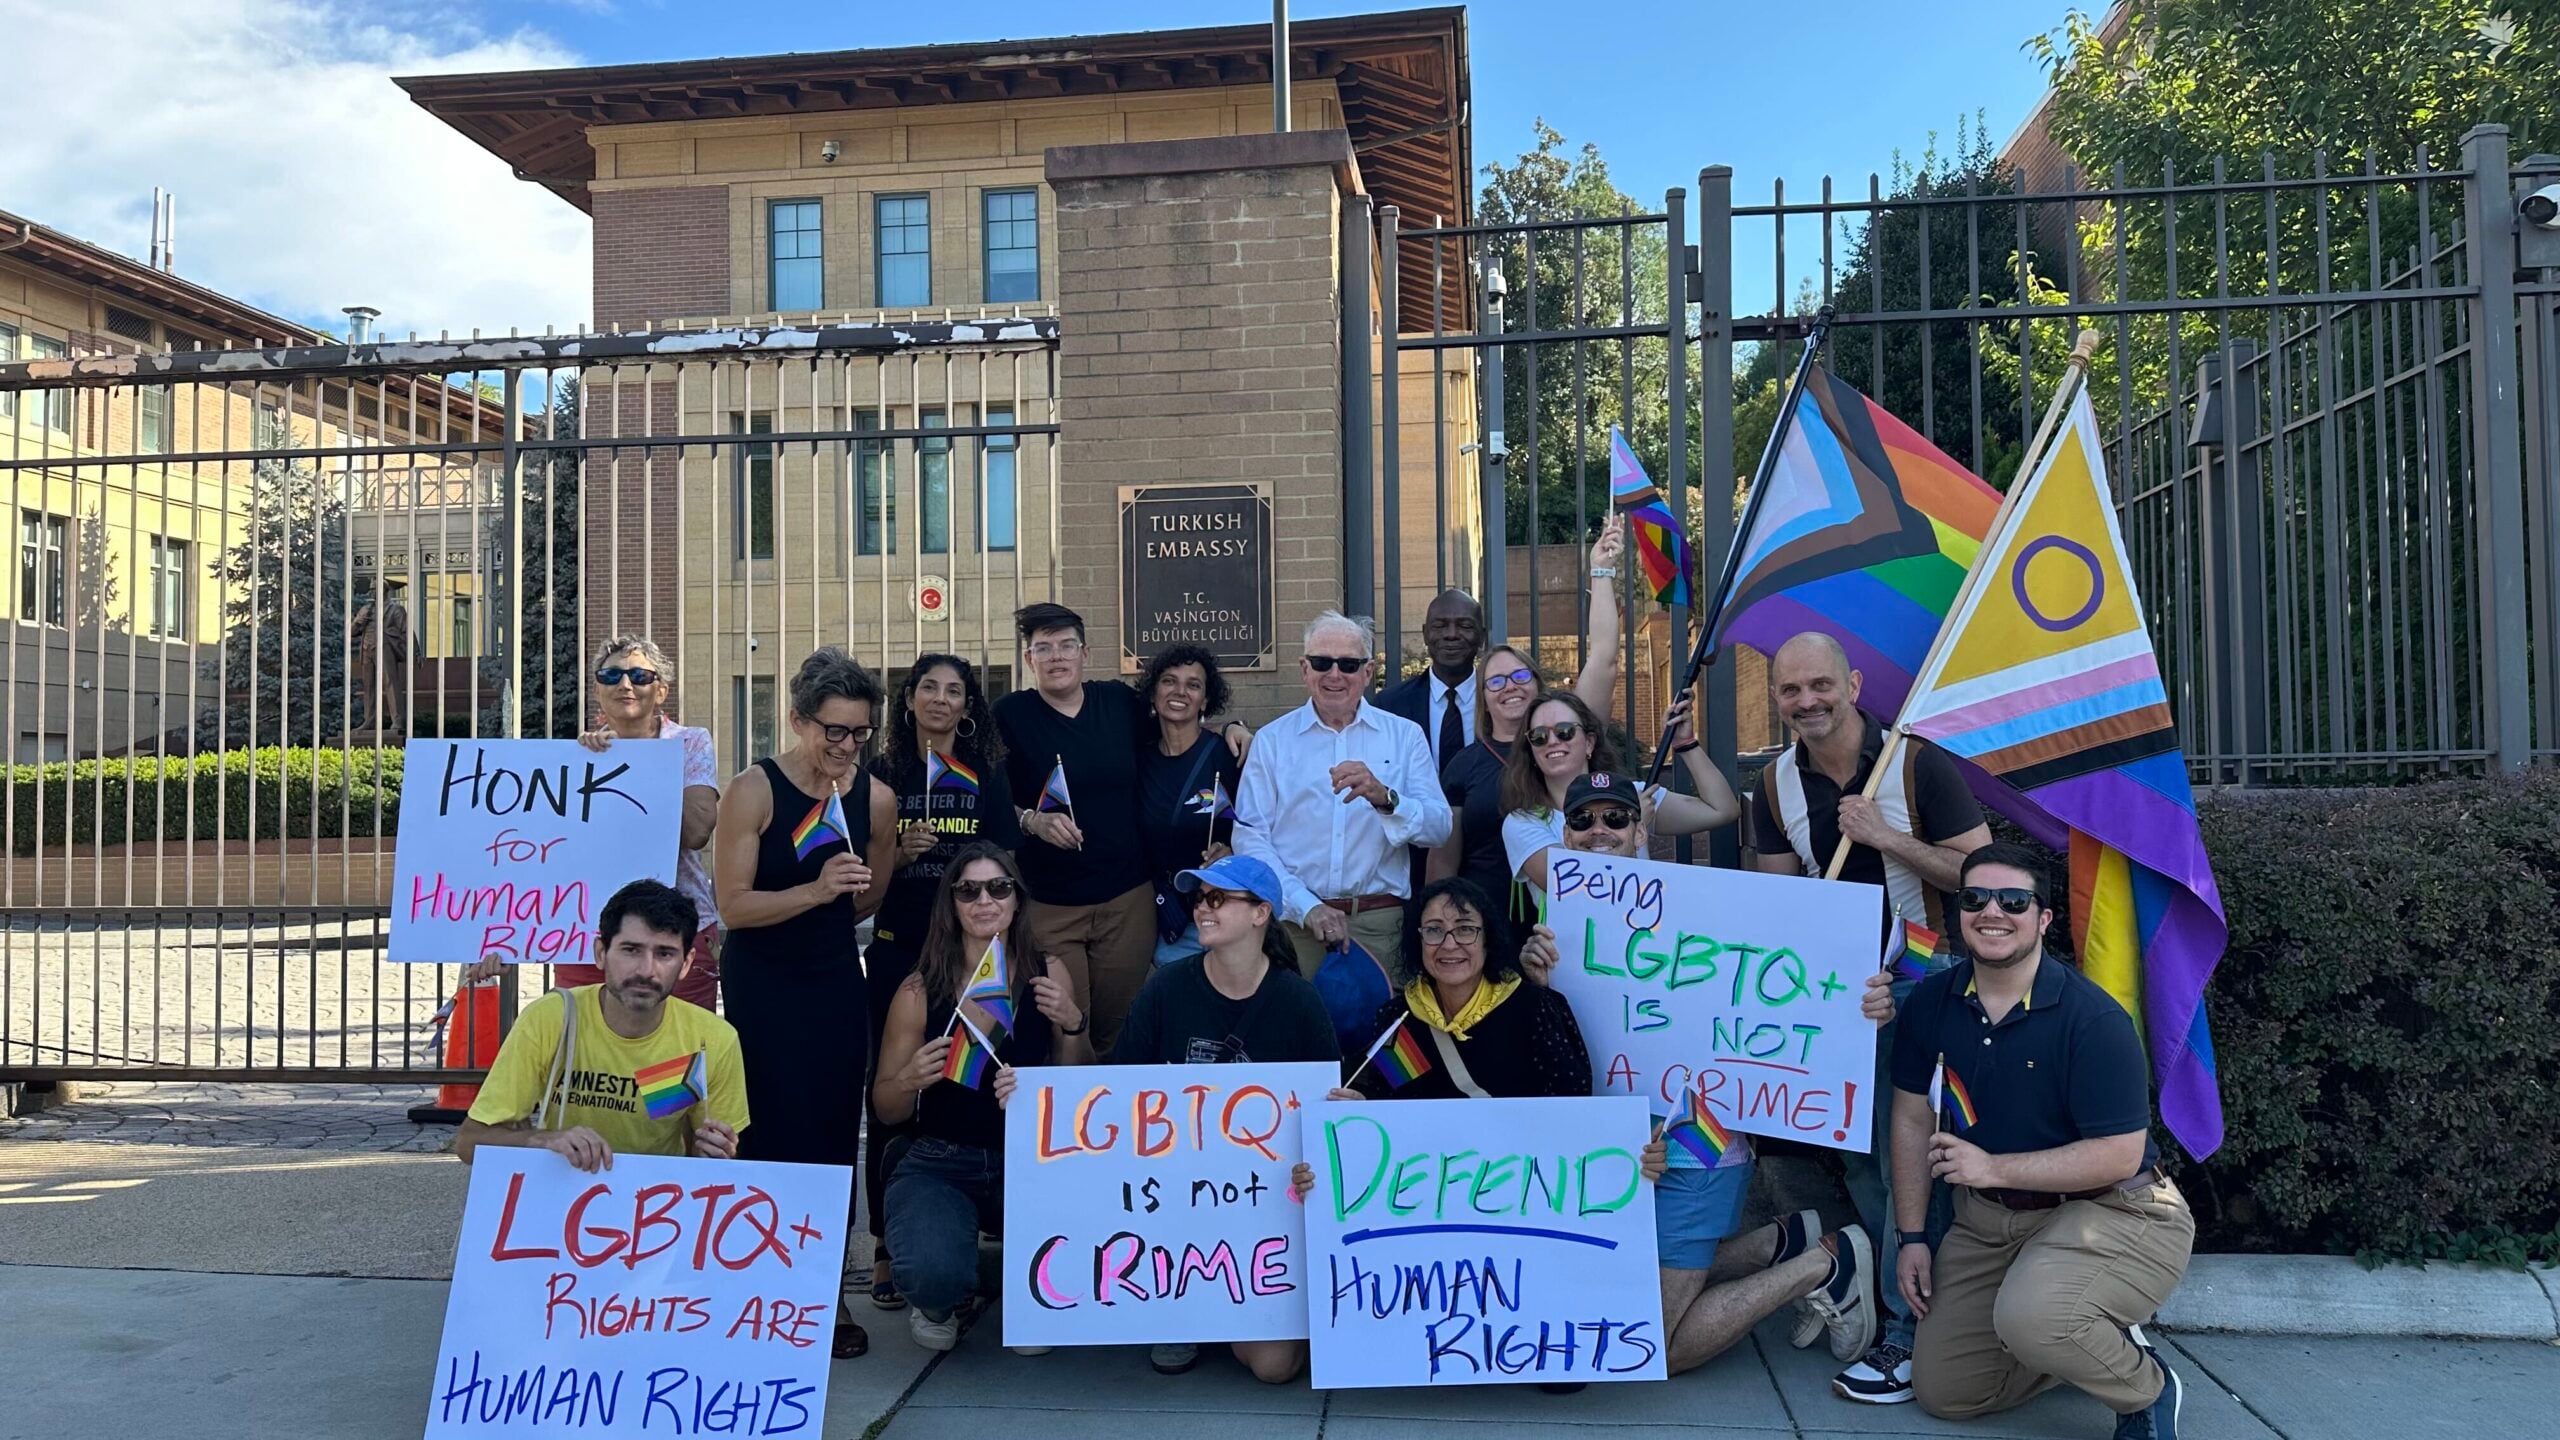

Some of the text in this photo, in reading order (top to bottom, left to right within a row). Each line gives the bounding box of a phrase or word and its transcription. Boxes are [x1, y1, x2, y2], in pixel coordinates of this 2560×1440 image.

[1146, 539, 1248, 559] EMBASSY
[1150, 513, 1242, 532] TURKISH
[1154, 608, 1240, 625] VAŞİNGTON
[1183, 592, 1210, 605] T.C.
[1142, 625, 1254, 643] BÜYÜKELÇİLİĞİ
[440, 743, 648, 823] HONK
[960, 794, 976, 810] TO
[485, 828, 568, 867] for
[928, 816, 980, 835] CANDLE
[411, 872, 590, 925] Human
[1553, 858, 1664, 931] Being
[1583, 916, 1848, 1008] LGBTQ+
[1623, 994, 1823, 1064] IS NOT
[551, 1091, 637, 1113] INERNATIONAL
[556, 1070, 639, 1098] AMNESTY
[1606, 1053, 1857, 1143] A CRIME!
[1036, 1084, 1302, 1164] LGBTQ+
[1191, 1171, 1269, 1208] not
[1323, 1115, 1640, 1222] DEFEND
[490, 1172, 823, 1271] LGBTQ+
[1029, 1231, 1296, 1310] CRIME
[1330, 1253, 1522, 1328] HUMAN
[545, 1272, 829, 1348] RIGHTS ARE
[1425, 1313, 1656, 1383] RIGHTS
[441, 1350, 817, 1436] HUMAN RIGHTS
